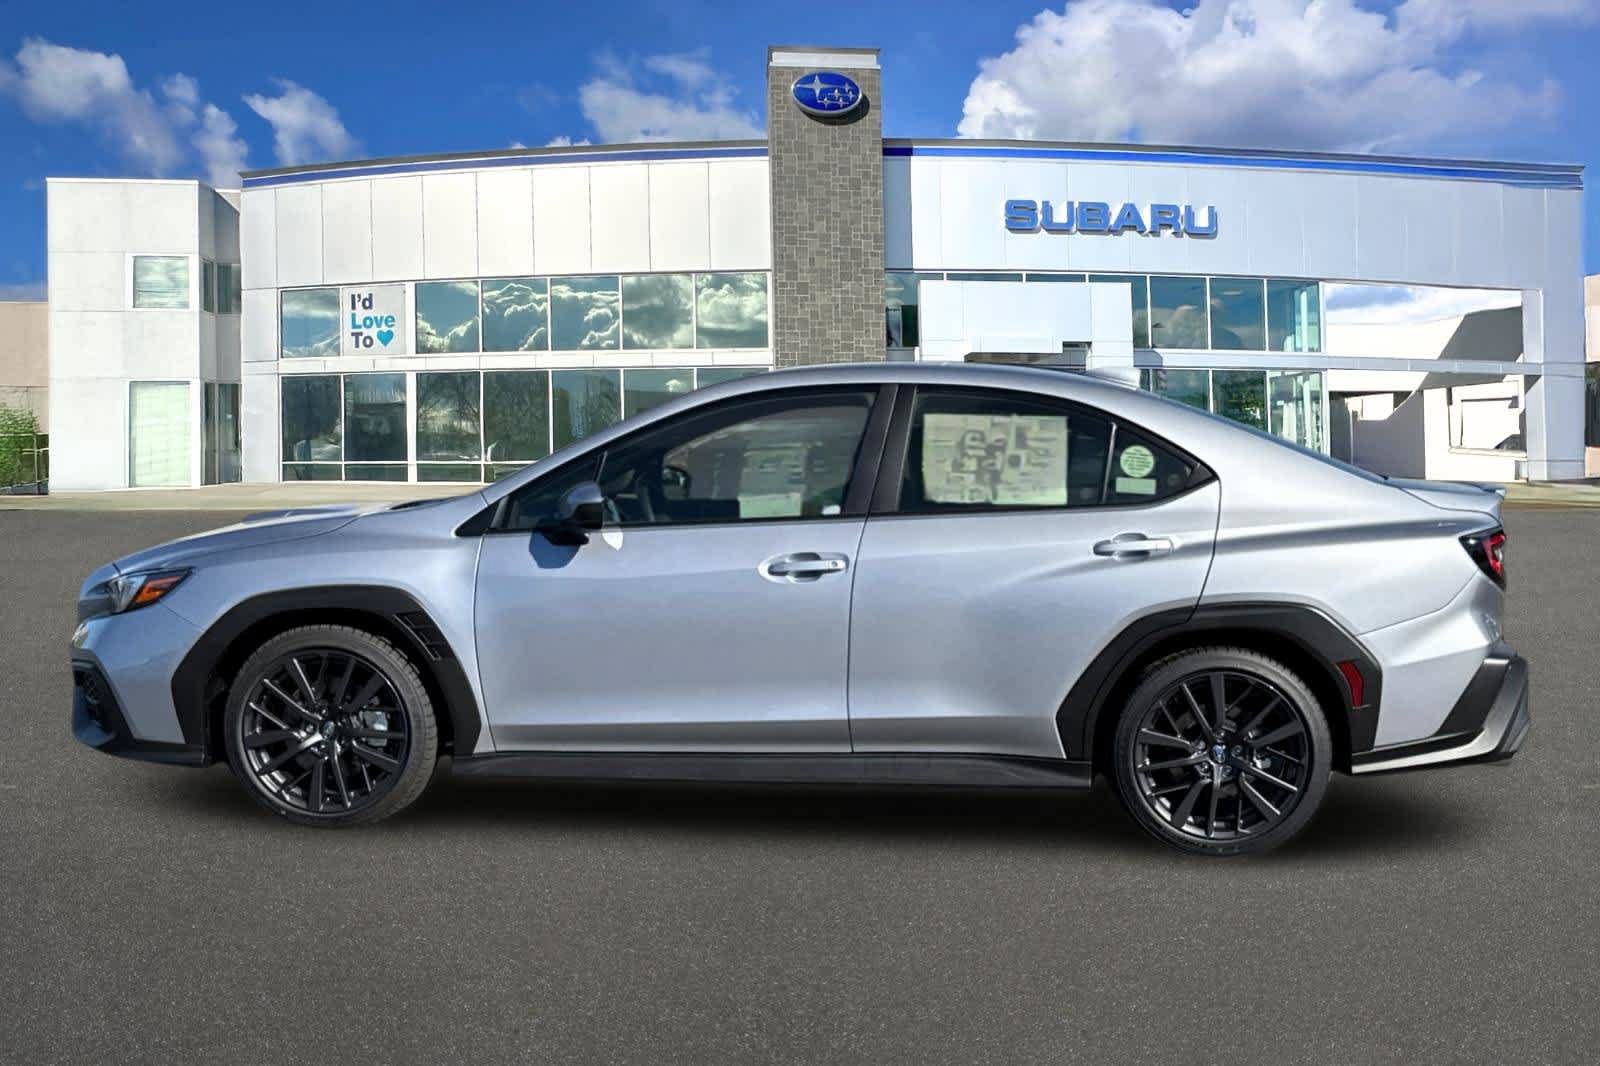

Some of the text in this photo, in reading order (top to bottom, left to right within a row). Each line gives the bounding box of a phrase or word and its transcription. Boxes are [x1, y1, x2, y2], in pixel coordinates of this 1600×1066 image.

[1005, 199, 1218, 239] SUBARU
[350, 293, 373, 310] I'd
[351, 312, 396, 329] Love
[350, 331, 374, 348] To
